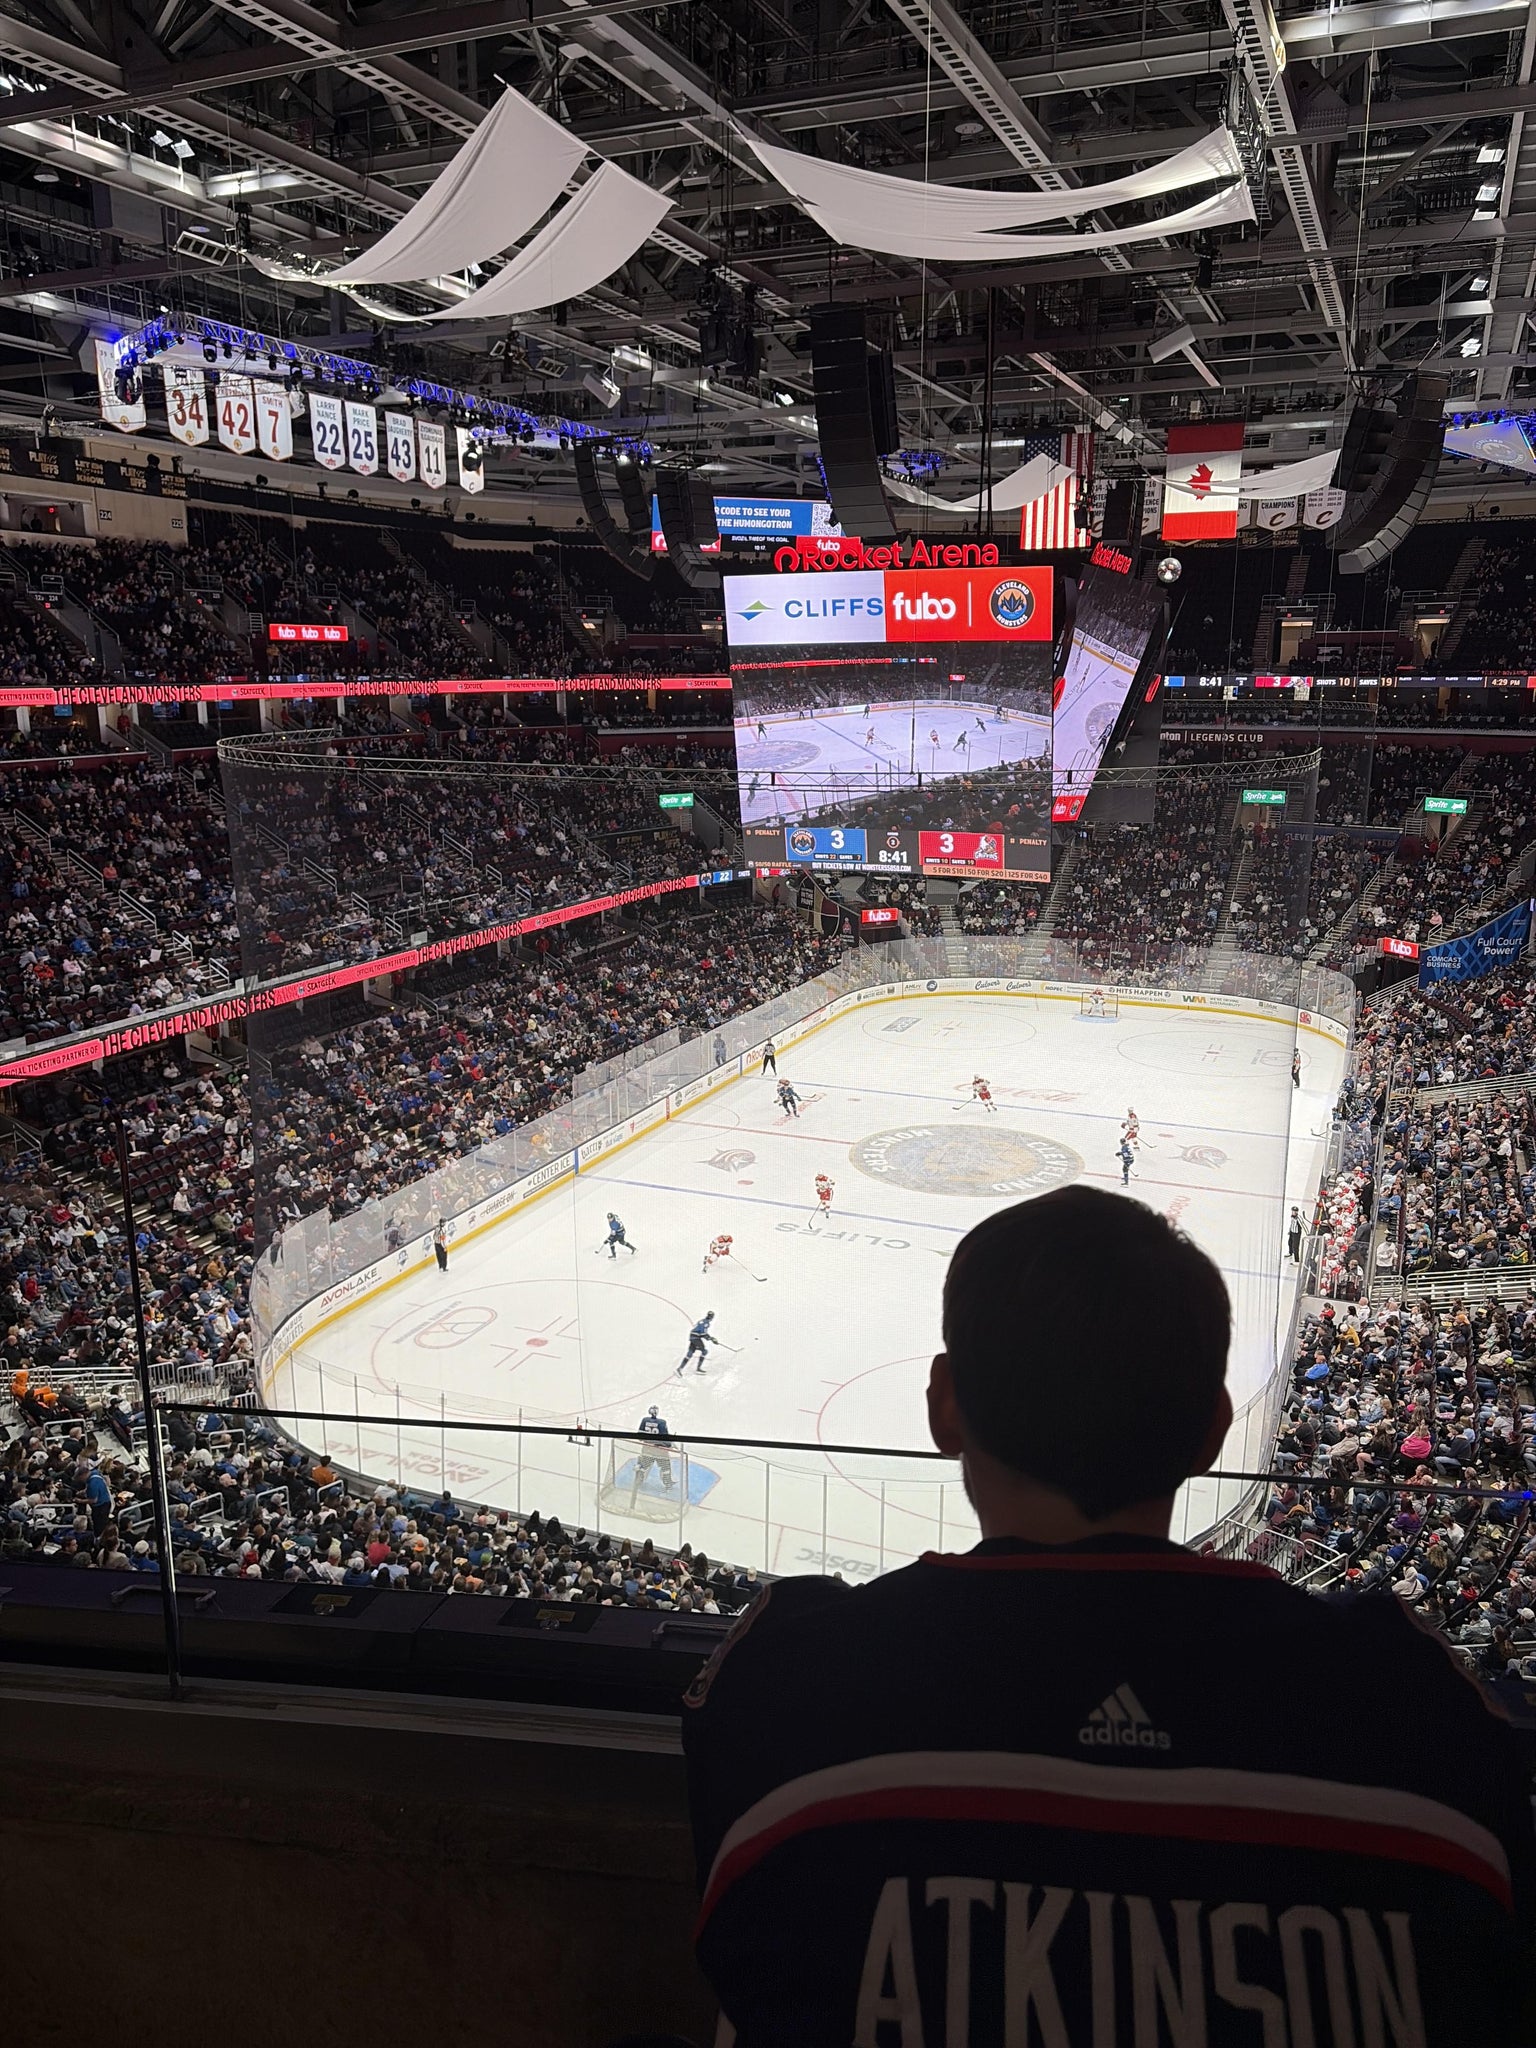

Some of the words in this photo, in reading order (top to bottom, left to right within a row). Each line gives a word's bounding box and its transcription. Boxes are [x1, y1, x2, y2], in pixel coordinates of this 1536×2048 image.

[172, 389, 204, 429] 34
[262, 396, 283, 408] SMITH
[316, 400, 336, 411] LARRY
[222, 400, 251, 438] 42
[316, 410, 337, 421] NANCE
[352, 408, 369, 418] MARK
[268, 410, 279, 443] 7
[353, 417, 370, 428] PRICE
[392, 417, 407, 427] BRAD
[316, 421, 341, 455] 22
[352, 428, 375, 462] 25
[391, 437, 412, 469] 43
[425, 445, 441, 475] 11
[721, 507, 740, 516] CODE
[743, 508, 752, 516] TO
[754, 508, 768, 516] SEE
[770, 508, 790, 517] YOUR
[1262, 501, 1294, 509] CHAMPIONS
[717, 518, 731, 527] THE
[733, 518, 792, 529] HUMONGOTRON
[803, 542, 902, 571] Rocket
[910, 539, 1000, 569] Arena
[995, 580, 1030, 595] CLEVELAND
[785, 597, 883, 618] CLIFFS
[893, 591, 956, 621] fubo
[996, 614, 1029, 627] MONSTERS
[278, 627, 295, 637] fubo
[302, 627, 318, 638] fubo
[324, 628, 340, 639] fubo
[346, 682, 360, 696] THE
[360, 681, 400, 696] CLEVELAND
[401, 681, 439, 695] MONSTERS
[556, 679, 569, 692] THE
[569, 678, 615, 691] CLEVELAND
[617, 677, 662, 691] MONSTERS
[1199, 677, 1222, 686] 8:41
[1273, 677, 1281, 687] 3
[1339, 677, 1350, 687] 10
[1381, 677, 1393, 687] 19
[1491, 678, 1507, 686] 4:29
[56, 687, 78, 704] THE
[78, 687, 143, 704] CLEVELAND
[147, 686, 202, 703] MONSTERS
[1191, 733, 1235, 743] LEGENDS
[1238, 733, 1264, 743] CLUB
[1245, 791, 1266, 801] Sprite
[1428, 800, 1448, 810] Sprite
[831, 830, 844, 849] 3
[939, 834, 954, 853] 3
[879, 850, 907, 863] 8:41
[720, 872, 729, 880] 22
[761, 868, 770, 876] 10
[952, 867, 964, 875] $10
[991, 869, 1004, 877] $20
[1034, 873, 1048, 881] $40
[652, 876, 687, 897] MONSTERS
[868, 911, 891, 922] fubo
[419, 948, 435, 964] THE
[435, 931, 481, 959] CLEVELAND
[482, 921, 523, 947] MONSTERS
[1390, 941, 1412, 956] fubo
[1478, 938, 1494, 946] Full
[1497, 937, 1522, 946] Court
[1484, 947, 1514, 956] Power
[307, 976, 337, 993] SEATGEEK
[1117, 987, 1132, 995] HITS
[1133, 989, 1163, 997] HAPPEN
[1183, 995, 1206, 1004] WM
[101, 1030, 131, 1057] THE
[131, 1008, 207, 1047] CLEVELAND
[212, 991, 275, 1025] MONSTERS
[27, 1056, 60, 1072] TICKETING
[62, 1048, 89, 1063] PARTNER
[90, 1045, 98, 1054] OF
[863, 1127, 934, 1173] MONSTERS
[533, 1164, 559, 1185] CENTER
[560, 1156, 571, 1171] ICE
[992, 1140, 1083, 1192] CLEVELAND
[775, 1221, 911, 1249] CLIFFS
[320, 1268, 377, 1308] AVONLAKE
[322, 1440, 482, 1484] AVONLAKE
[409, 1451, 490, 1475] CDJR.COM
[795, 1547, 880, 1577] EDSEC
[1078, 1719, 1172, 1750] adidas
[854, 1876, 1426, 2048] ATKINSON
